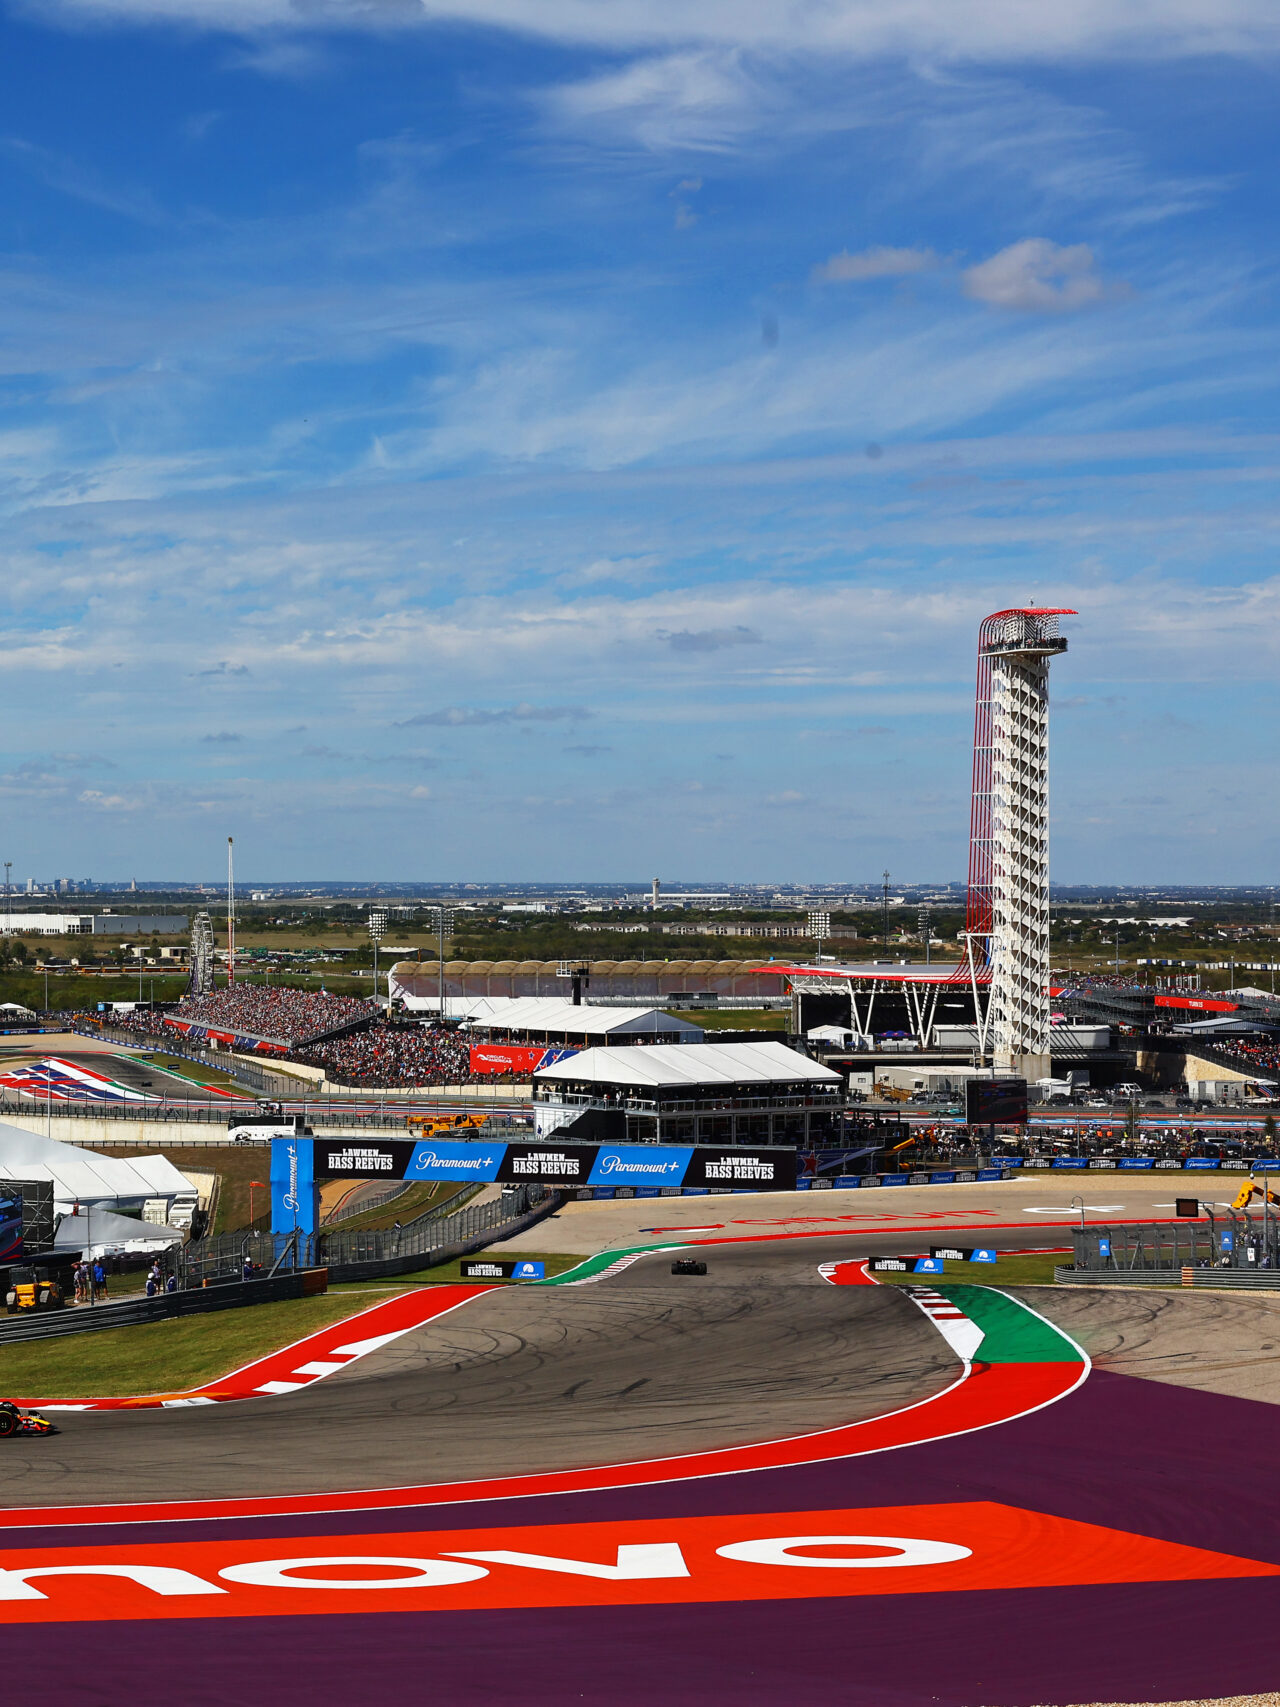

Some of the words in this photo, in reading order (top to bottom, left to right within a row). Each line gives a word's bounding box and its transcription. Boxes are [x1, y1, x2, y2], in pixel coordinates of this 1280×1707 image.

[342, 1149, 379, 1157] LAWMEN
[527, 1153, 565, 1161] LAWMEN
[328, 1157, 353, 1169] BASS
[355, 1157, 393, 1170] REEVES
[416, 1151, 493, 1170] Paramount+
[600, 1156, 679, 1174] Paramount+
[720, 1157, 760, 1165] LAWMEN
[513, 1161, 539, 1174] BASS
[540, 1162, 580, 1175] REEVES
[705, 1165, 732, 1178] BASS
[734, 1166, 774, 1179] REEVES
[731, 1210, 1000, 1225] CIRCUIT
